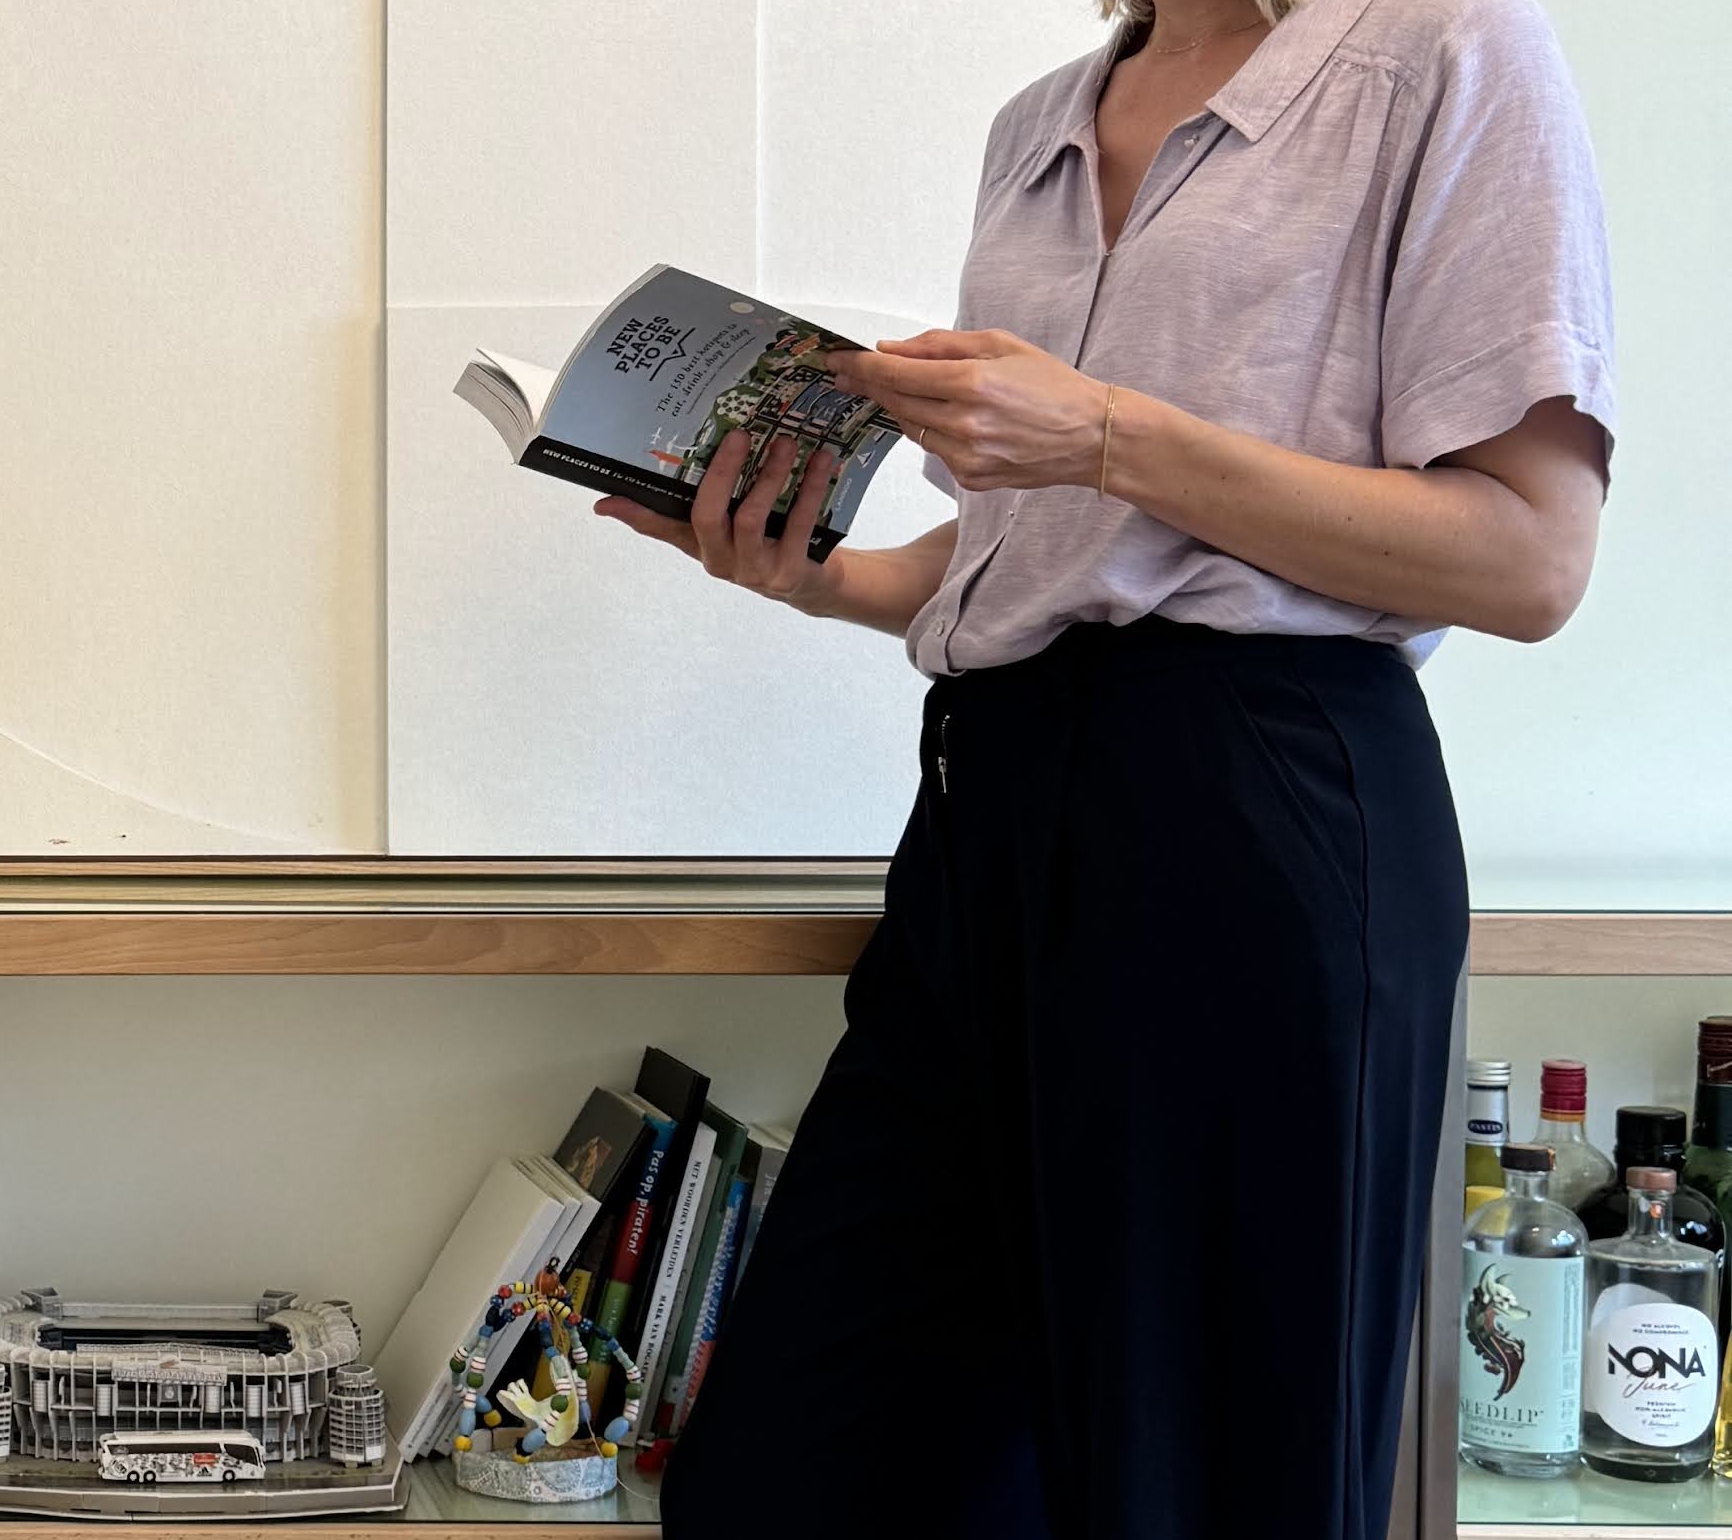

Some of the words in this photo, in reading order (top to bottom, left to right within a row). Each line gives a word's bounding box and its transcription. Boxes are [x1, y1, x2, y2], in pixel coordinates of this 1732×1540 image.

[606, 318, 644, 356] NEW
[614, 316, 669, 374] PLACES
[634, 347, 661, 369] TO
[655, 326, 681, 345] BE
[657, 393, 674, 412] The
[670, 373, 685, 390] 150
[682, 370, 707, 396] drink,
[542, 447, 561, 460] NEW
[559, 452, 589, 471] PLACES
[588, 462, 600, 473] TO
[647, 1148, 664, 1174] Pas
[689, 1159, 701, 1179] MET
[637, 1173, 654, 1197] op,
[677, 1180, 696, 1226] WOORDEN
[624, 1196, 650, 1257] piraten!
[654, 1294, 667, 1320] MARK
[649, 1322, 659, 1340] VAN
[1608, 1342, 1706, 1379] NONA
